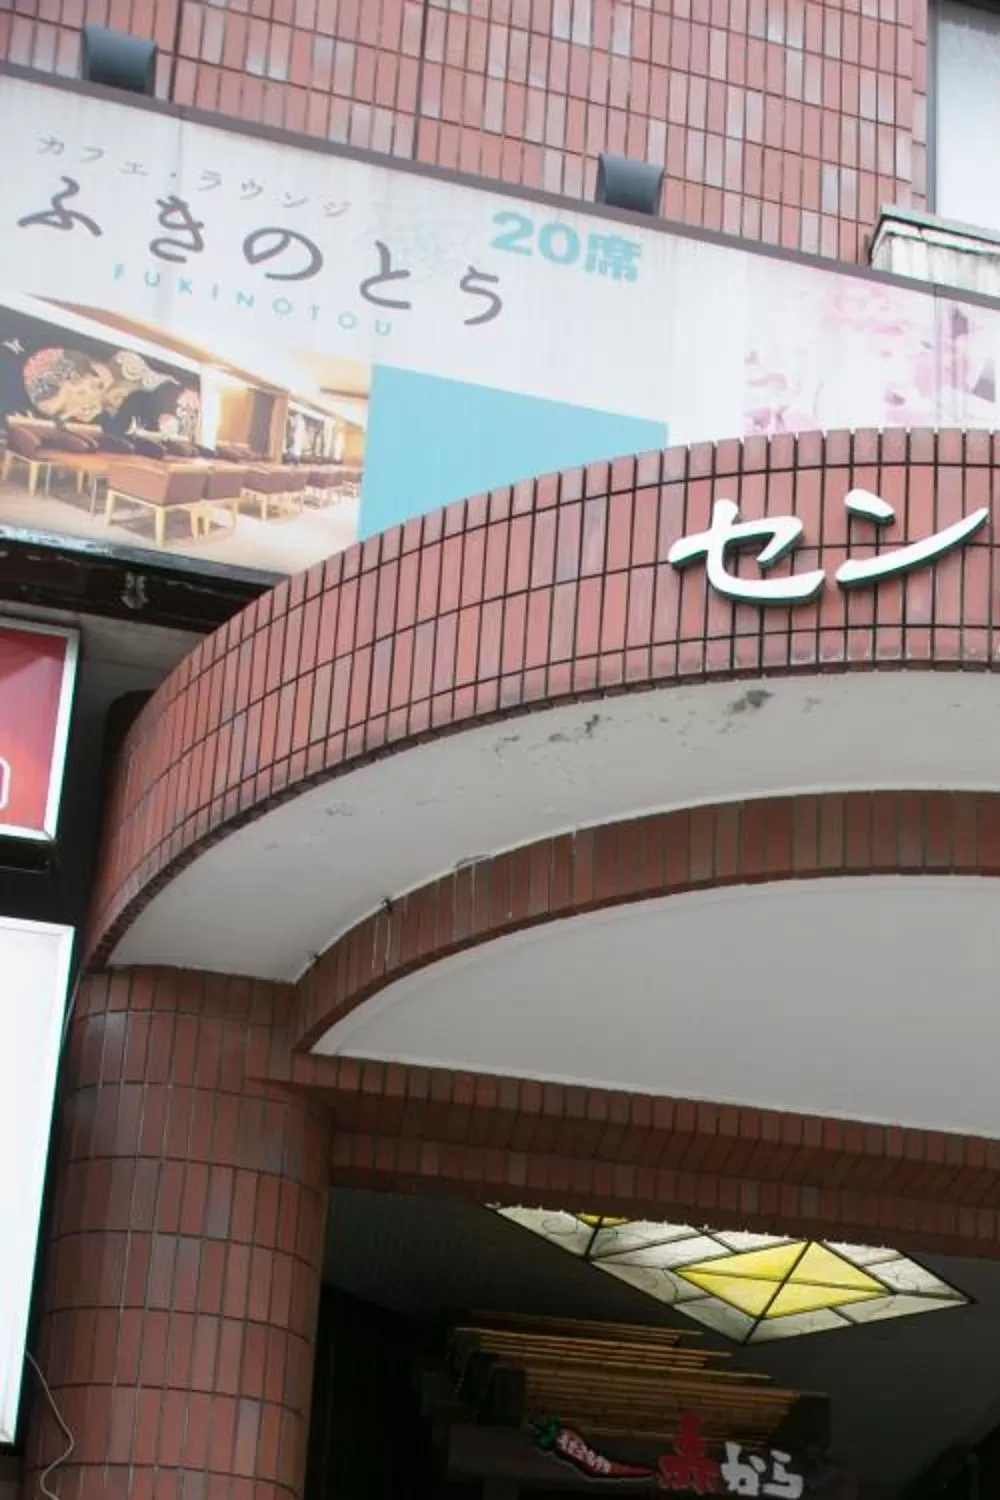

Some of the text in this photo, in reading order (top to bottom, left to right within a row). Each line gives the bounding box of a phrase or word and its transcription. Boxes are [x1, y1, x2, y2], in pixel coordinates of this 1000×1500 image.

[17, 175, 503, 326] ふきのとう
[490, 209, 643, 284] 20席
[112, 262, 394, 338] FUKINOTOU
